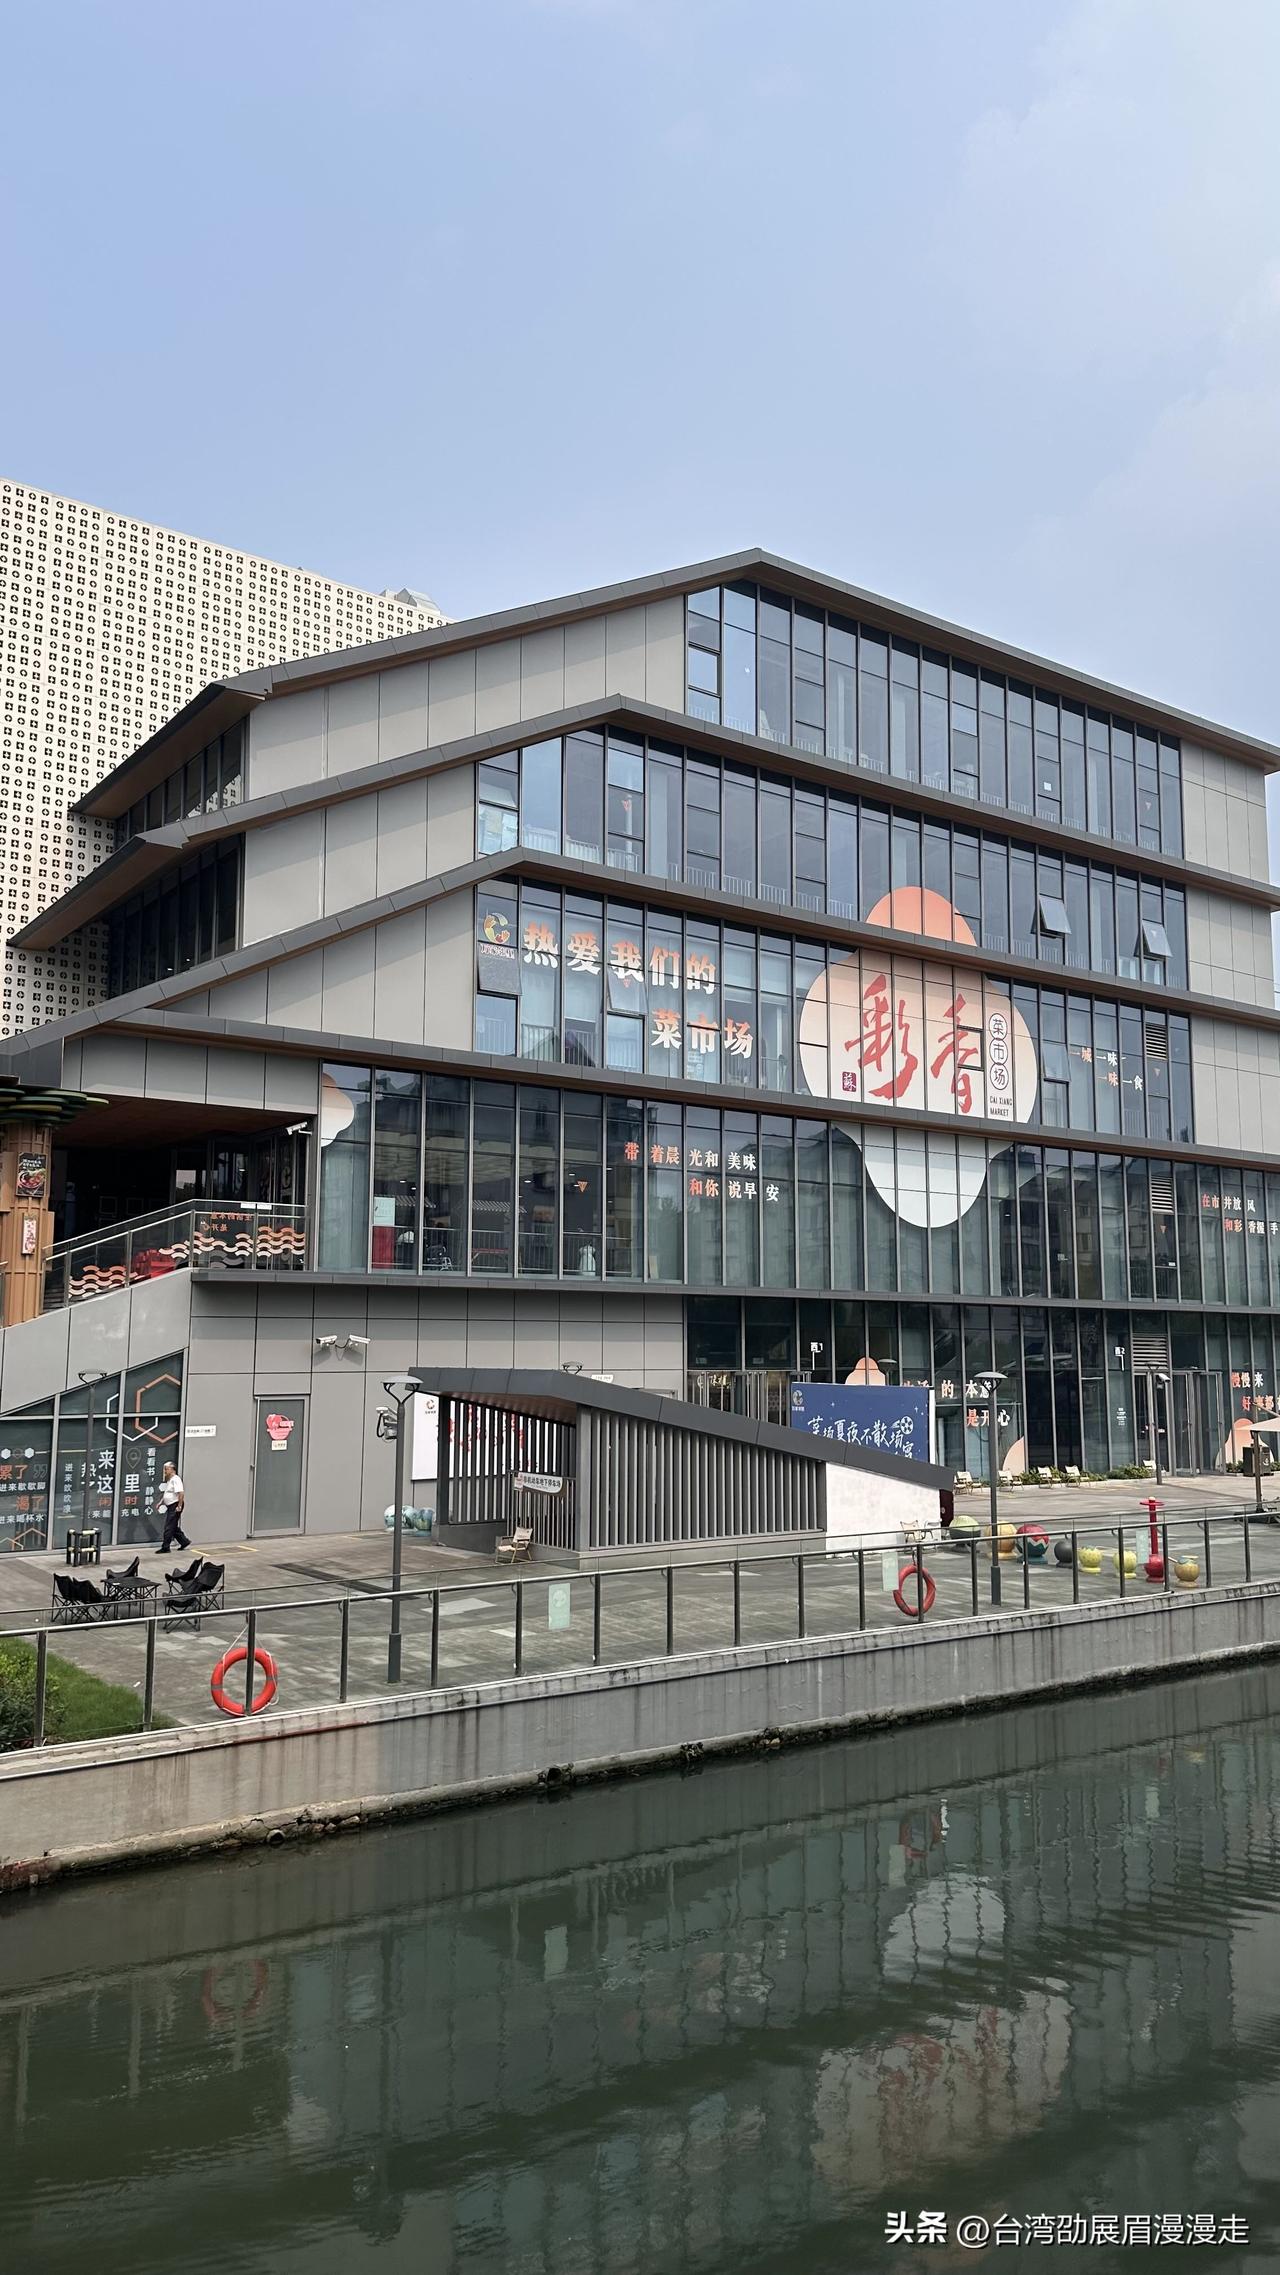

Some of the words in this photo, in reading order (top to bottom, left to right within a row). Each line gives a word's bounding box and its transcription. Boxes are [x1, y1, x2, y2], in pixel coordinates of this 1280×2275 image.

[523, 921, 716, 994] 热爱我们的
[651, 1007, 753, 1059] 菜市场
[990, 1016, 1007, 1088] 菜市场
[989, 1107, 1009, 1117] MARKET
[624, 1142, 757, 1171] 带着晨光和美味
[689, 1178, 780, 1202] 和你说早安
